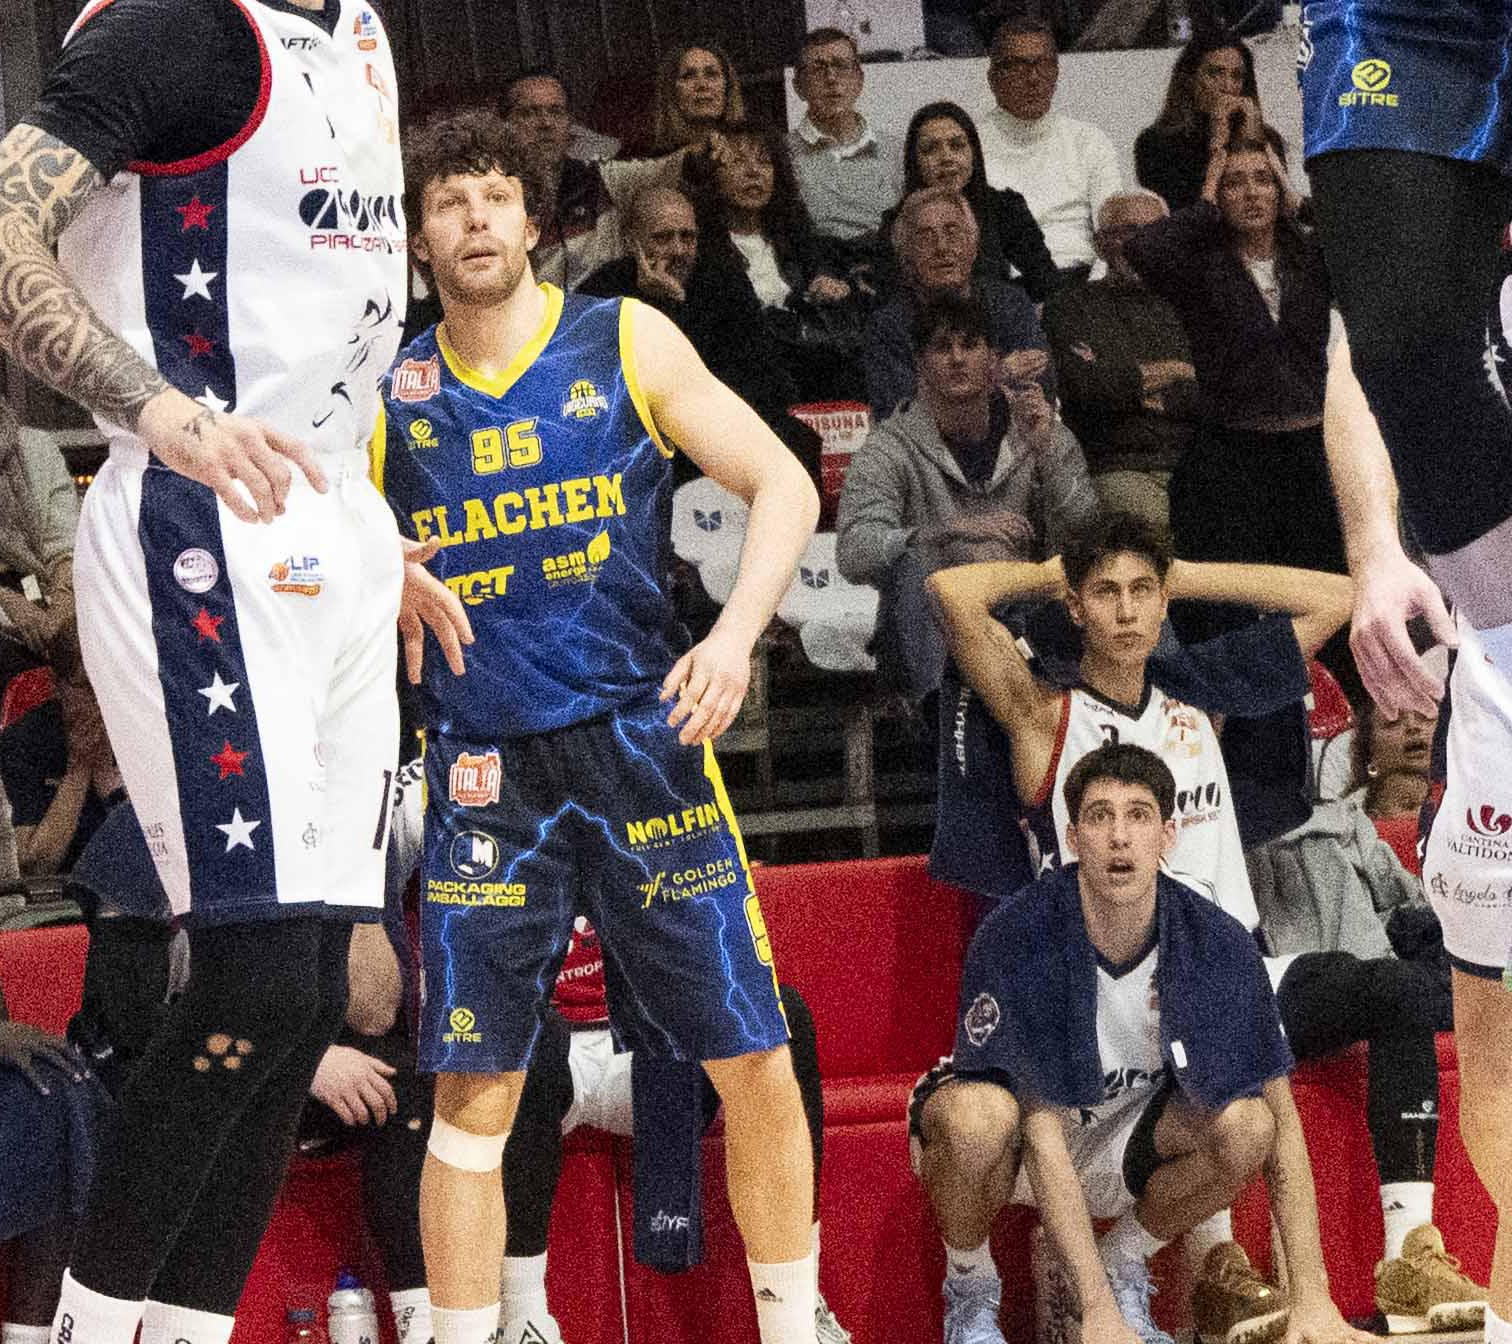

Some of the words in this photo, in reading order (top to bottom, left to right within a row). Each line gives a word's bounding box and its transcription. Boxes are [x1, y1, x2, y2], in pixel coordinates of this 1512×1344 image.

[1339, 93, 1399, 107] BITRE
[471, 416, 542, 475] 95
[411, 473, 626, 548] ELACHEM
[543, 551, 586, 573] asm
[626, 801, 721, 845] NOLFIN
[1461, 834, 1509, 848] CANTINA
[673, 857, 733, 885] GOLDEN
[427, 880, 526, 895] PACKAGING
[662, 871, 737, 903] FLAMINGO
